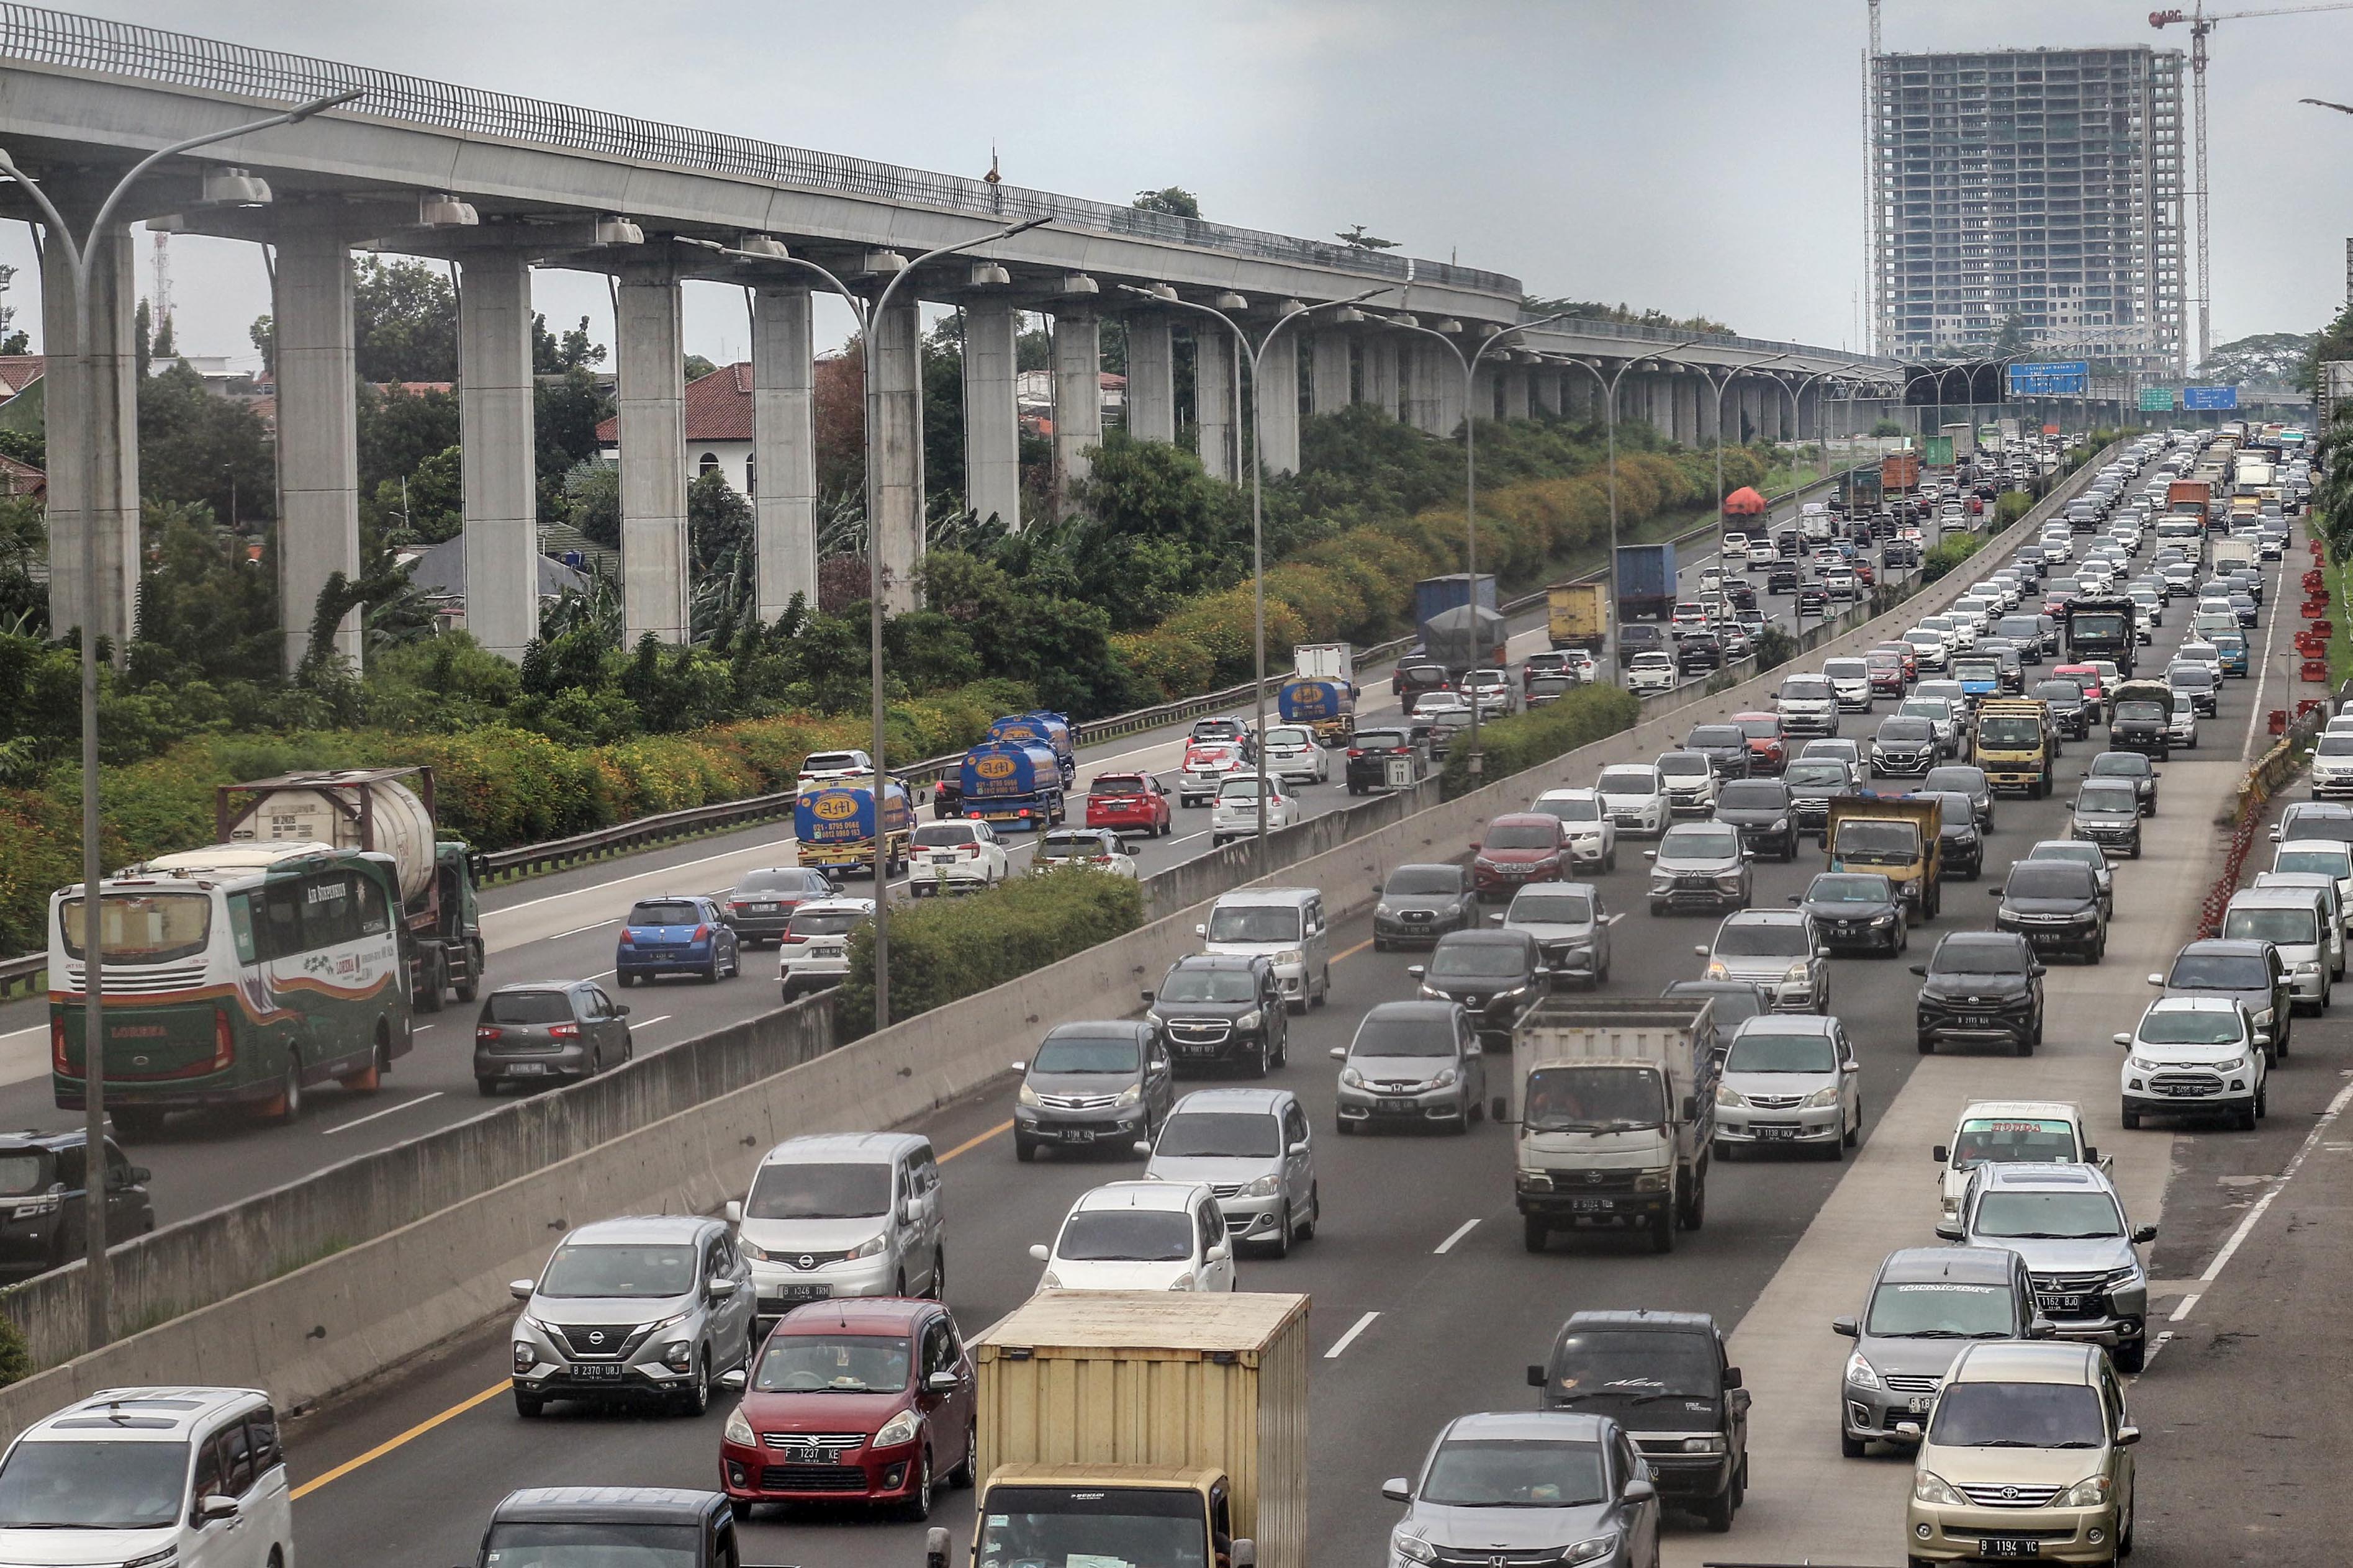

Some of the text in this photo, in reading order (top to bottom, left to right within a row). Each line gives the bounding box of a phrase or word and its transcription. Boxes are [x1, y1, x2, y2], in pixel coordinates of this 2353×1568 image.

[1396, 771, 1404, 782] 11
[820, 800, 851, 815] AM
[784, 1286, 788, 1295] B
[2042, 1297, 2059, 1306] 1162
[574, 1366, 579, 1375] B
[582, 1366, 600, 1375] 2370
[785, 1447, 839, 1459] F 1237 KE
[1981, 1540, 2037, 1552] B 1194 YC
